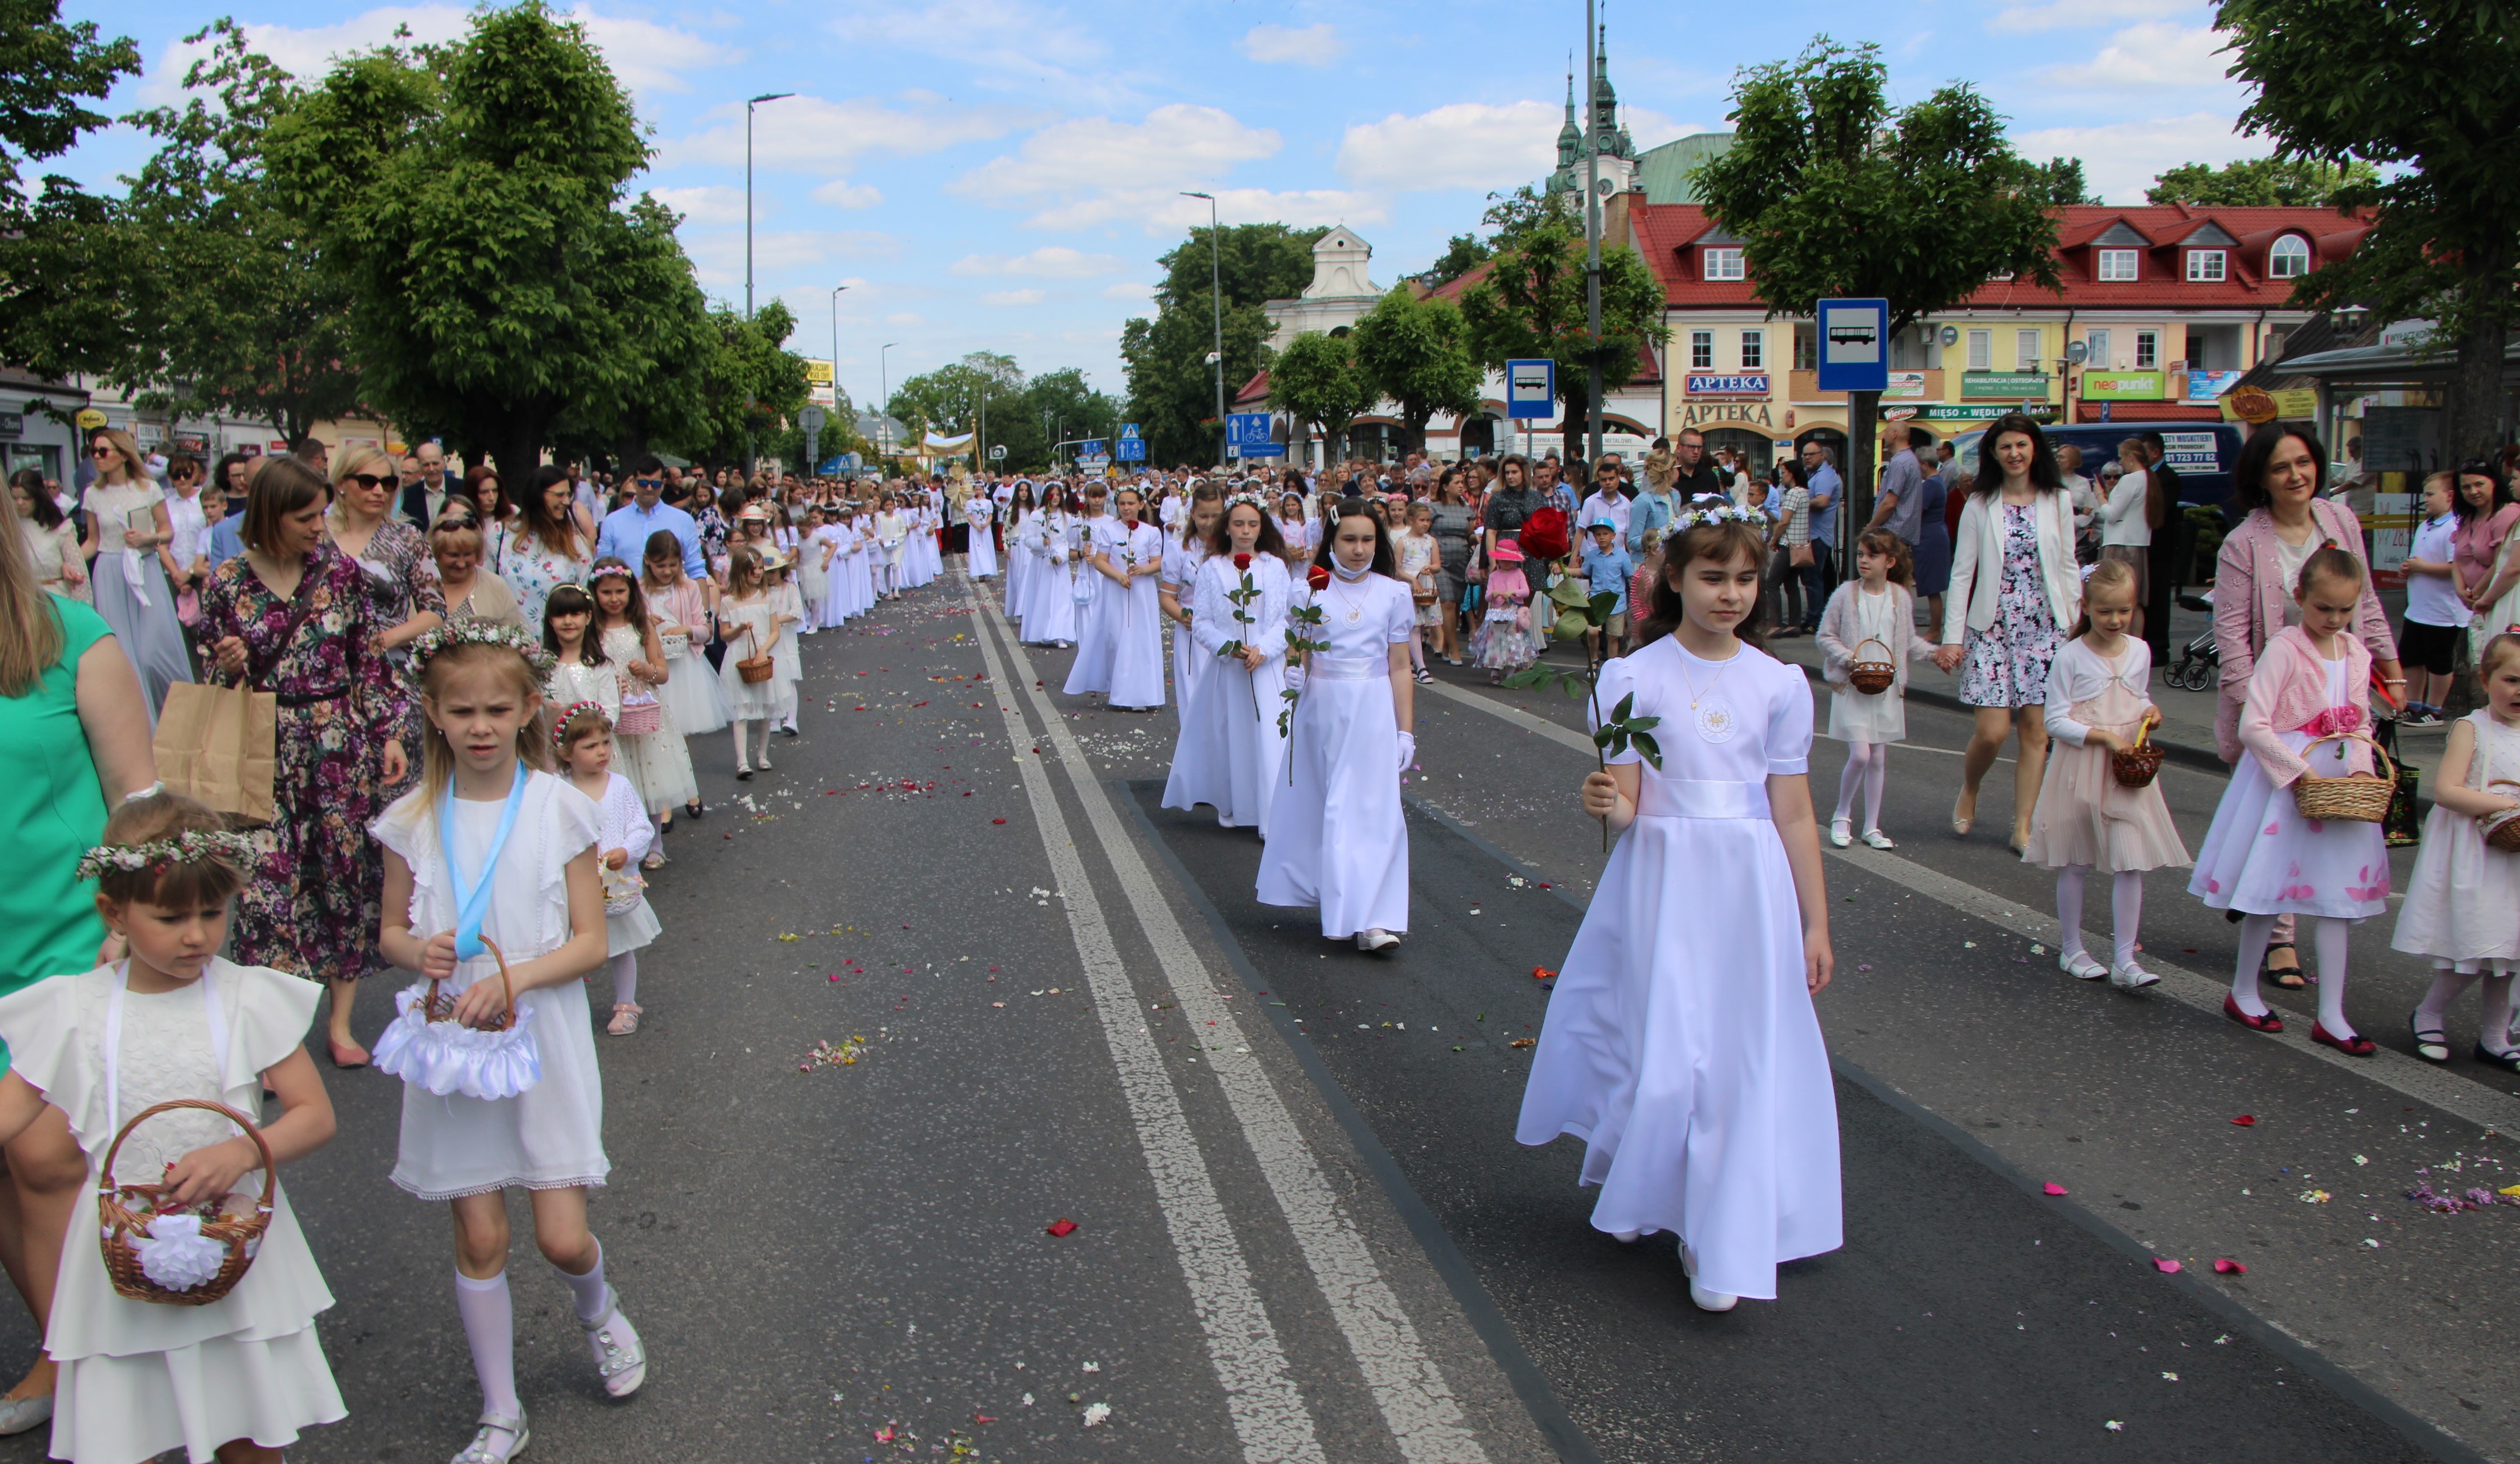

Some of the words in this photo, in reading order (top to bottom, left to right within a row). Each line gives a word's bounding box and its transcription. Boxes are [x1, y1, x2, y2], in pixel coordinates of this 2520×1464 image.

[1691, 377, 1765, 389] APTEKA
[2094, 377, 2154, 393] neopunkt
[1681, 405, 1773, 429] APTEKA
[1929, 409, 1960, 419] MIĘSO
[2102, 403, 2108, 419] P
[2177, 434, 2212, 443] MOSKITIERY
[2165, 453, 2174, 462] 81
[2177, 453, 2191, 462] 723
[2194, 453, 2203, 462] 77
[2206, 453, 2216, 462] 82
